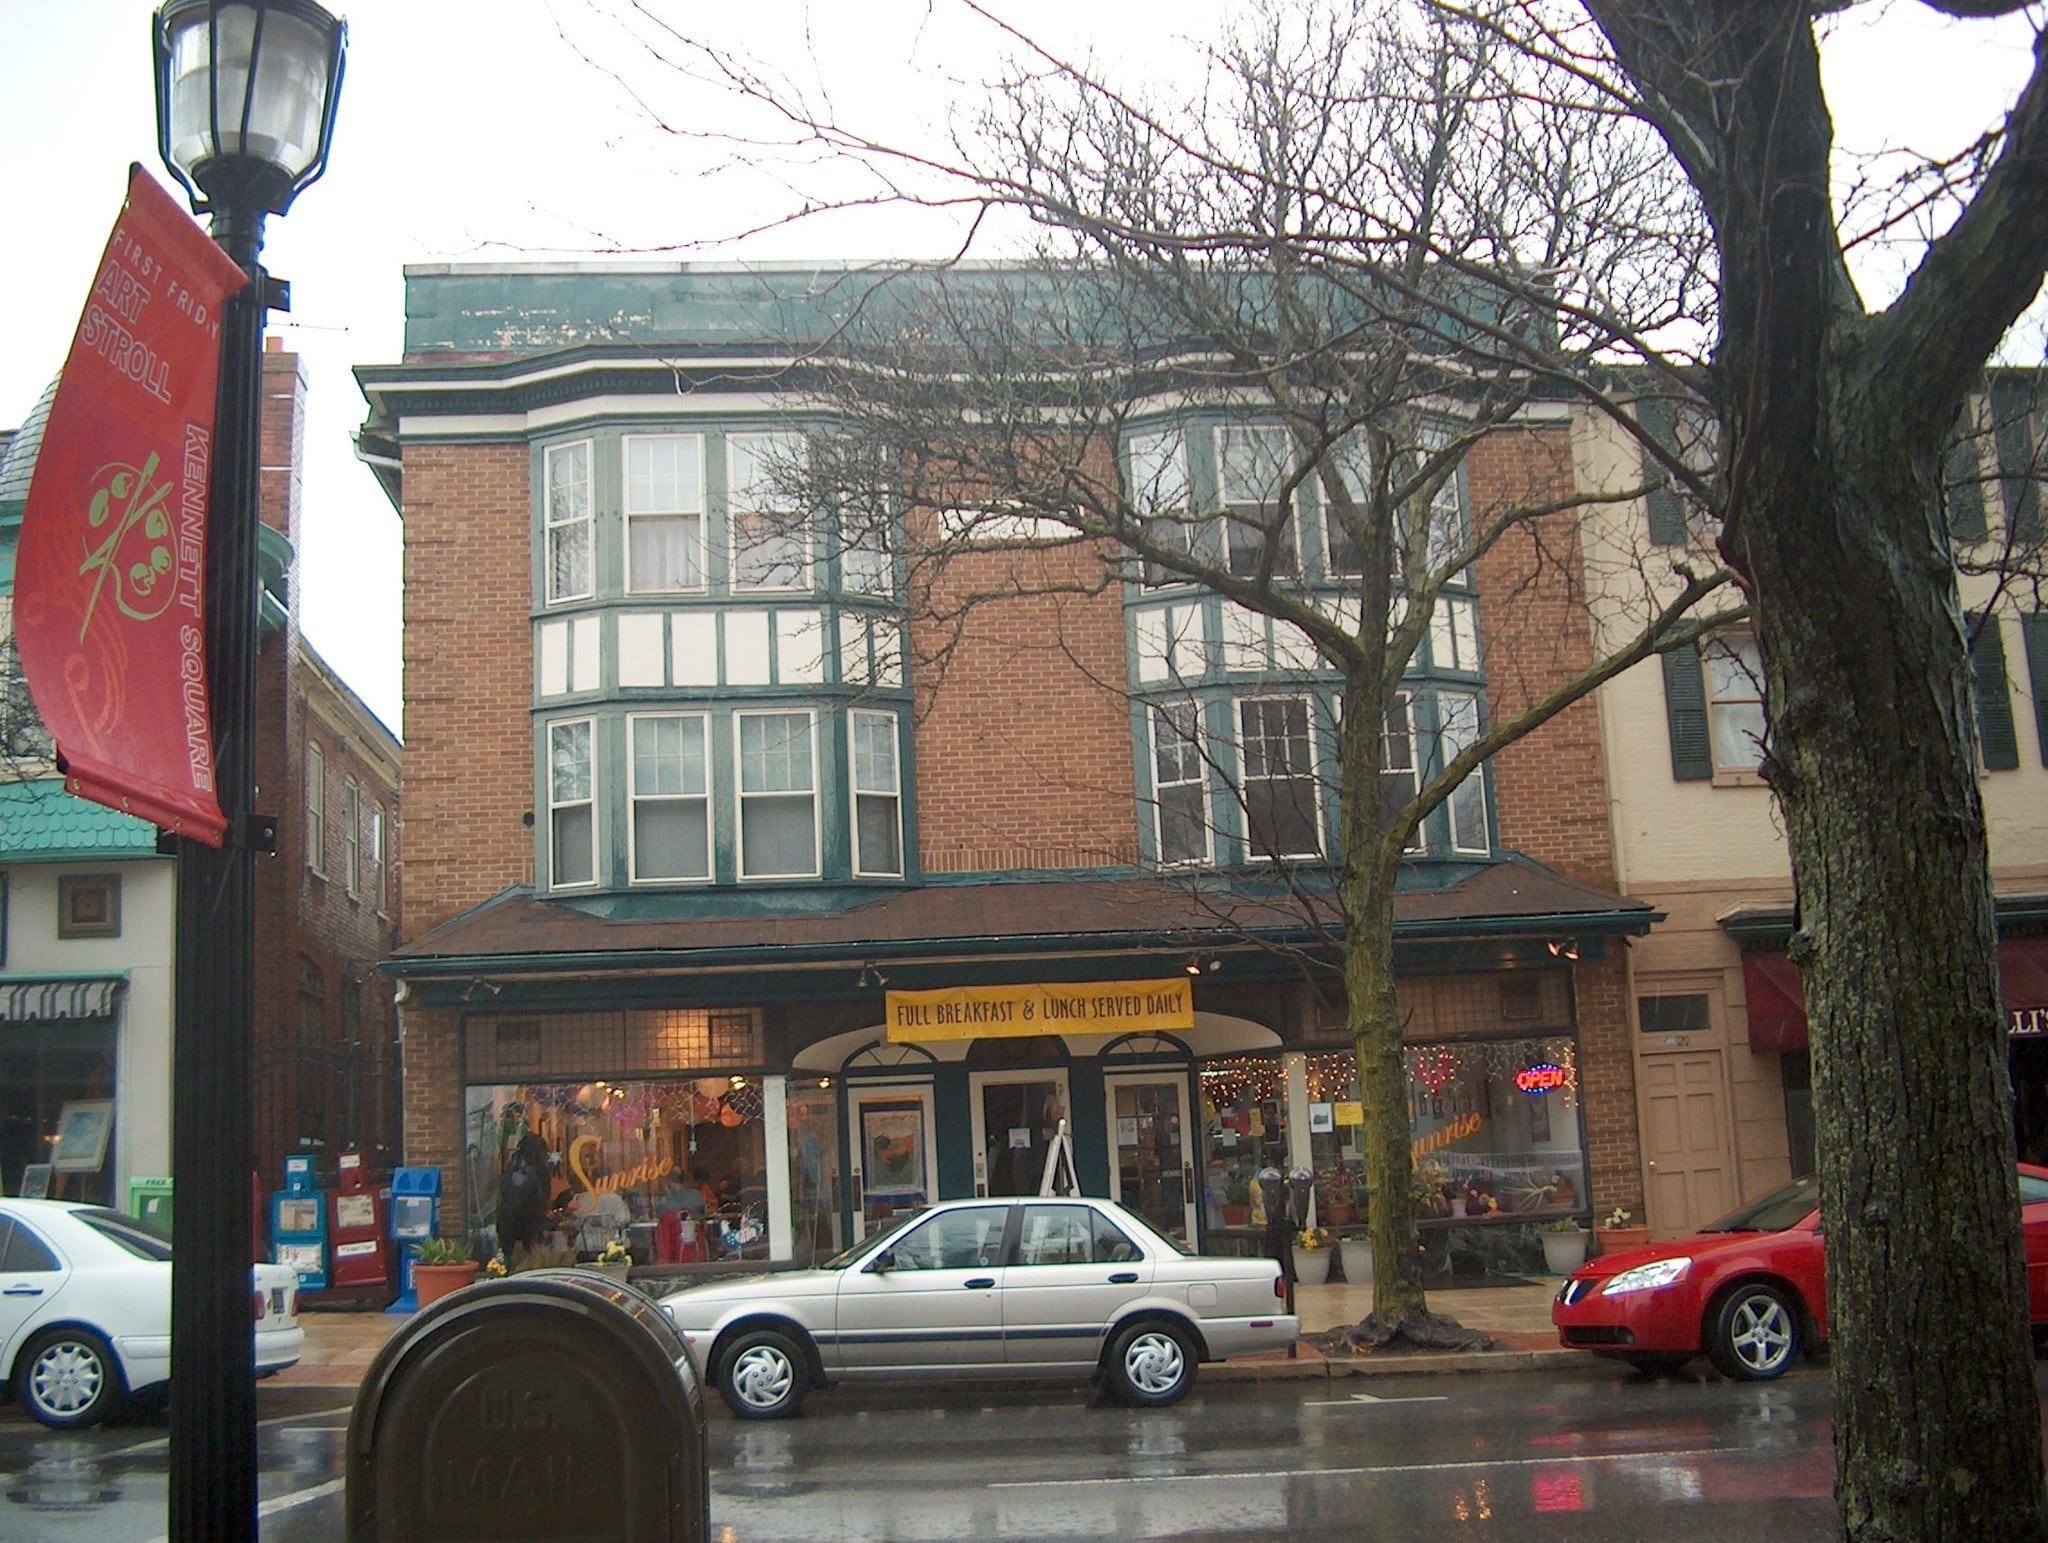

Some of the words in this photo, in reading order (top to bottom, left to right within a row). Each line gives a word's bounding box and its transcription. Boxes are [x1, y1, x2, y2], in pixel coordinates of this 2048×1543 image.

[113, 228, 162, 282] FIRST
[96, 260, 150, 325] ART
[81, 304, 172, 404] STROLL
[179, 423, 210, 618] KENNETT
[180, 625, 212, 792] SQUARE
[897, 1005, 931, 1026] FULL
[936, 1000, 1014, 1024] BREAKFAST
[1022, 1001, 1035, 1021] &
[1043, 997, 1086, 1020] LUNCH
[1092, 995, 1141, 1018] SERVED
[1146, 993, 1183, 1016] DAILY
[1516, 1069, 1564, 1089] OPEN
[569, 1135, 674, 1213] Sunrise
